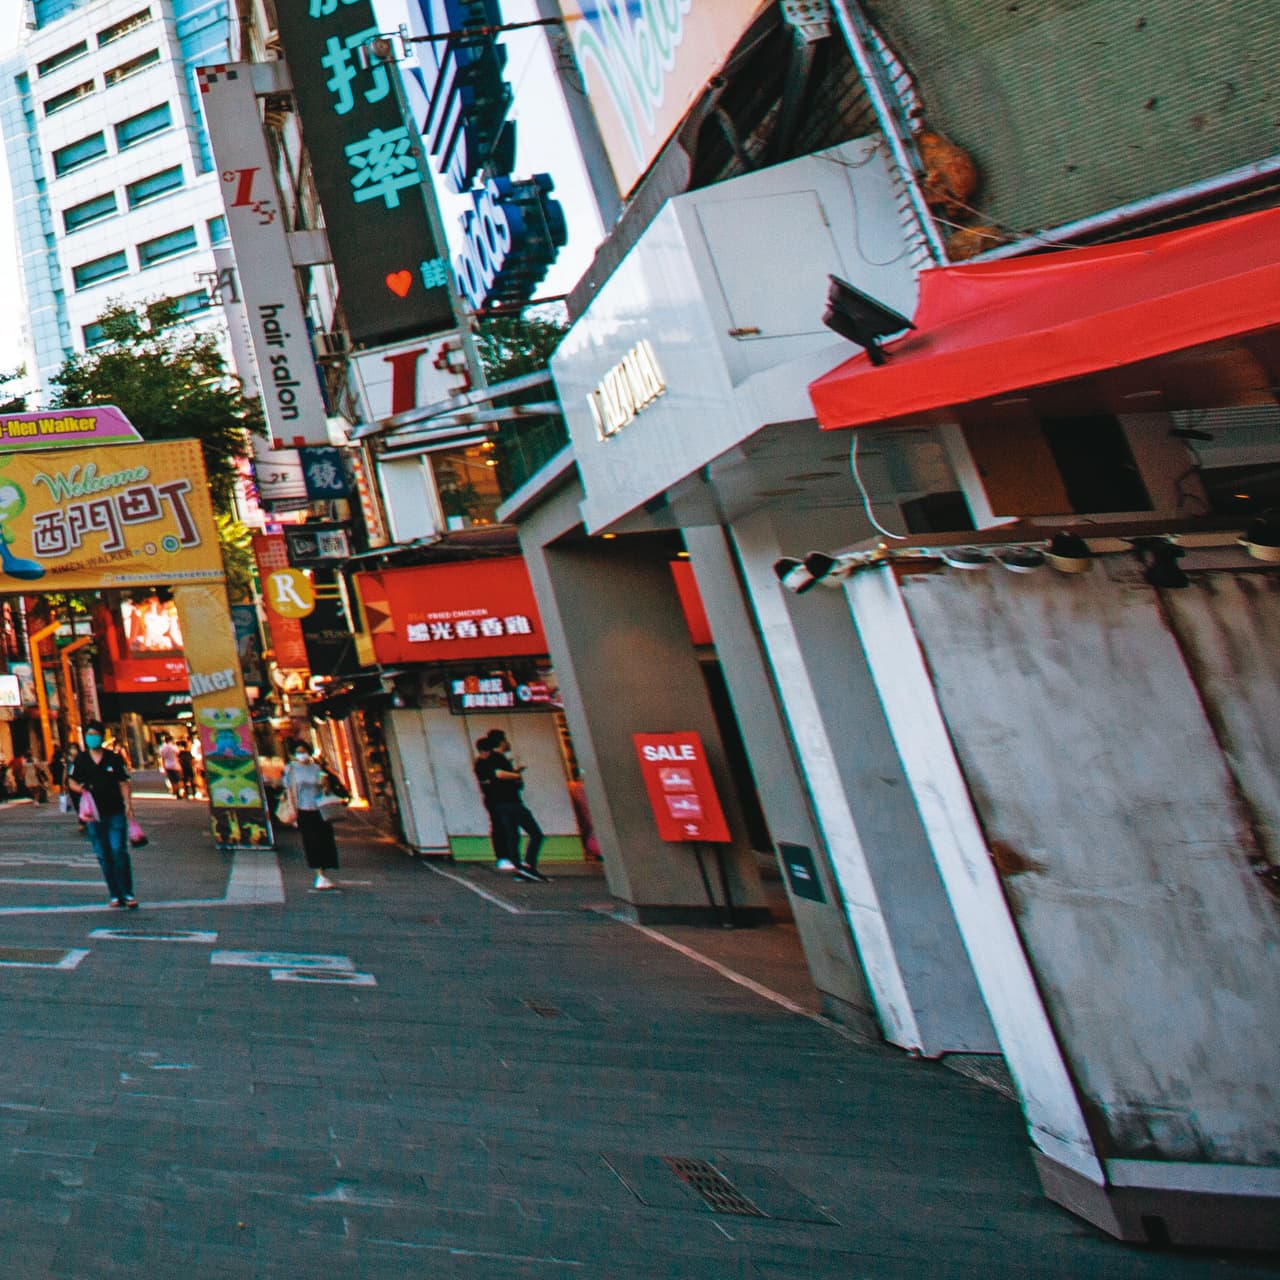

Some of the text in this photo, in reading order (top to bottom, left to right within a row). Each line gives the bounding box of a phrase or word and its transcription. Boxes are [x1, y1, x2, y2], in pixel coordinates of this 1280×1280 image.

[259, 303, 300, 421] hair salon
[39, 417, 97, 434] Walker
[33, 462, 149, 504] Welcome
[32, 480, 200, 559] 西門町
[643, 745, 696, 761] SALE
